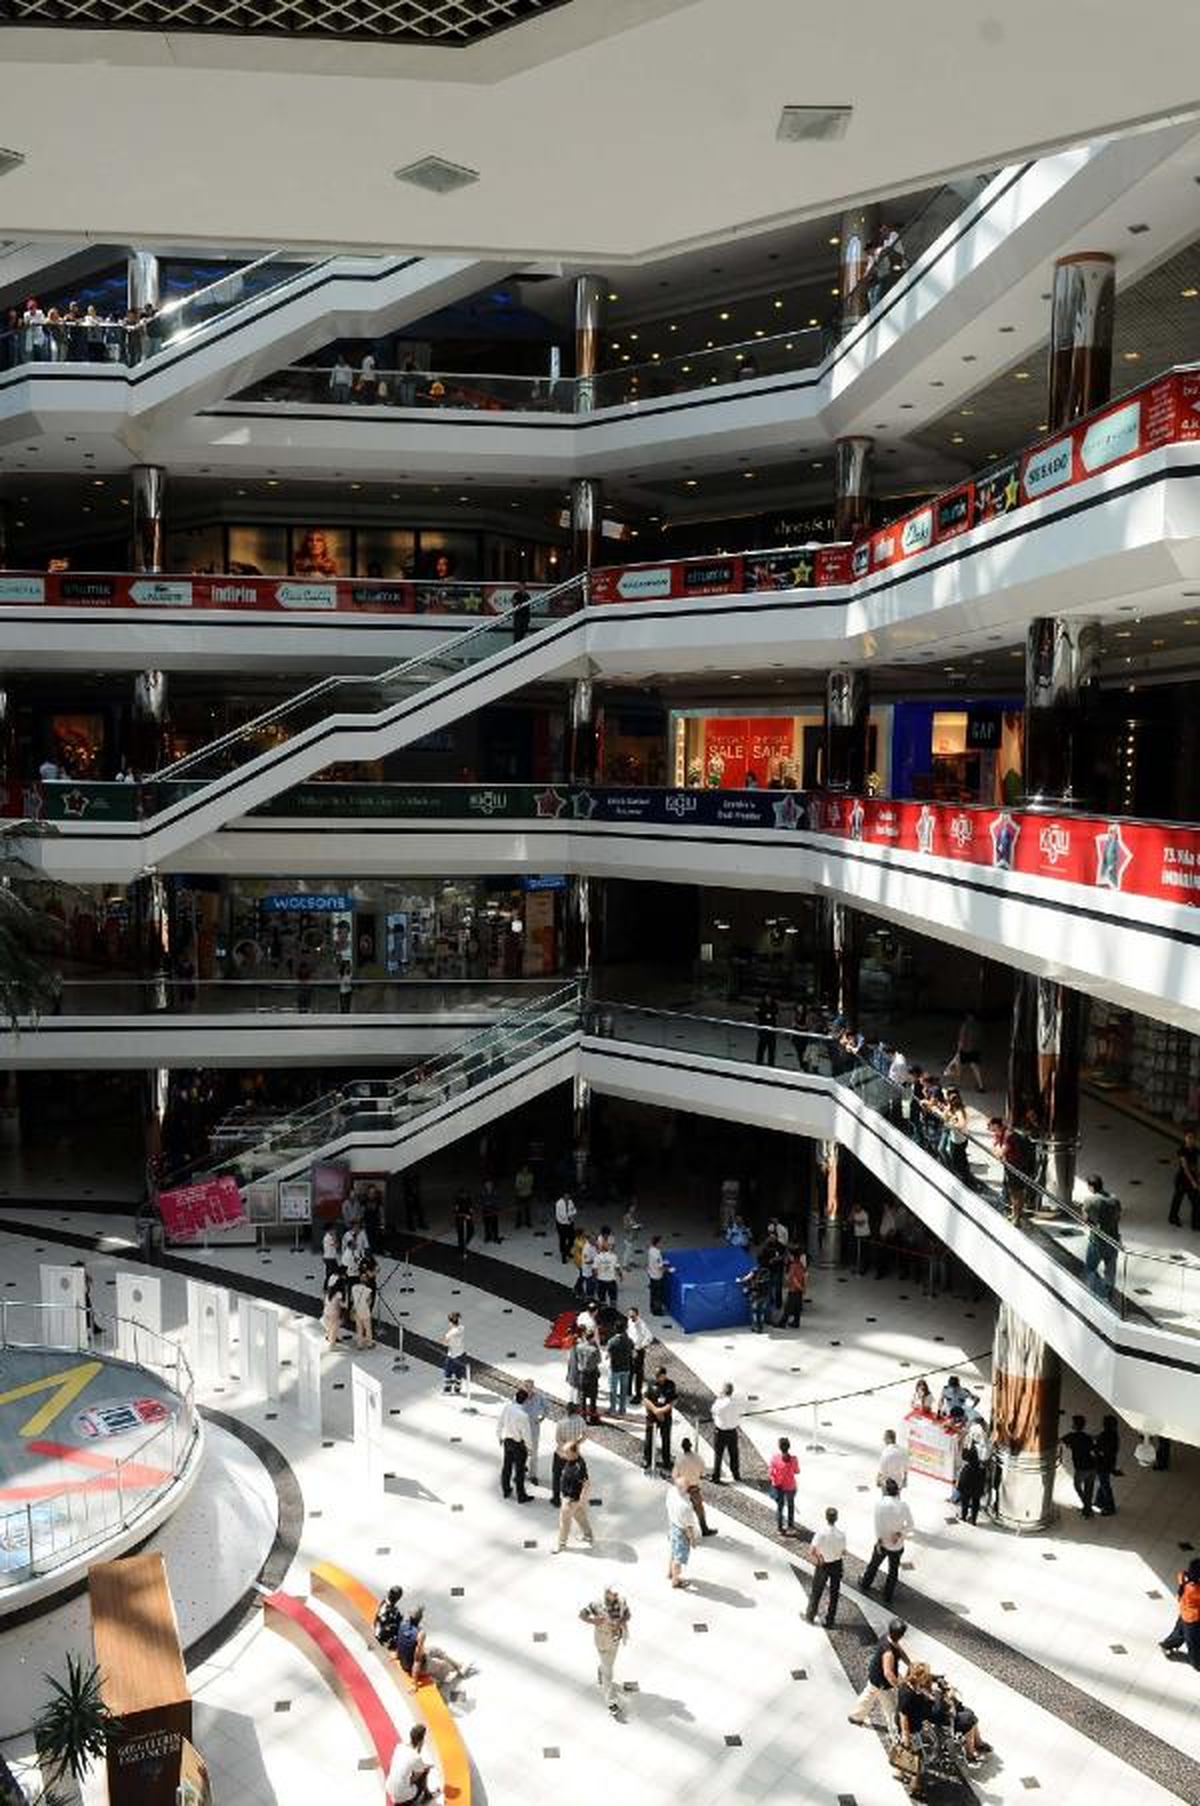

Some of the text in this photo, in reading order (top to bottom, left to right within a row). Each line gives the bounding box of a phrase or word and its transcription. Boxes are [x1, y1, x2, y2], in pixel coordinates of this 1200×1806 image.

[971, 720, 996, 741] GAP
[709, 745, 744, 759] SALE
[752, 745, 790, 759] SALE
[273, 896, 345, 910] watsons
